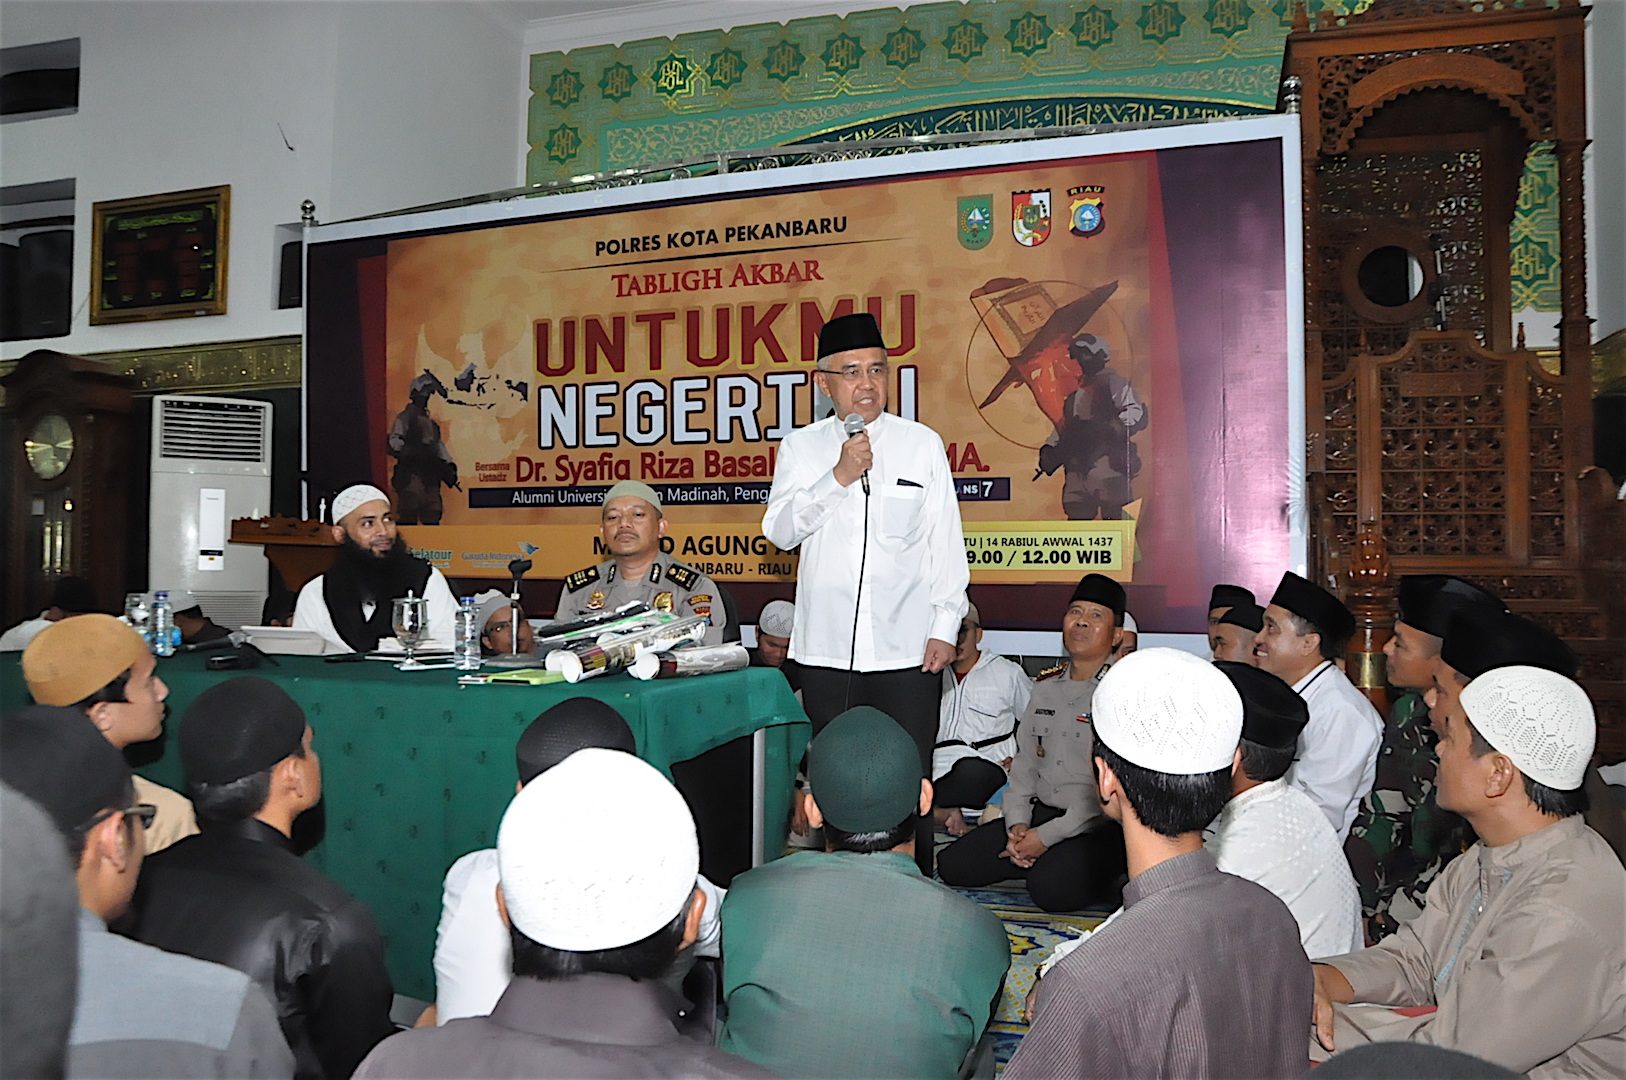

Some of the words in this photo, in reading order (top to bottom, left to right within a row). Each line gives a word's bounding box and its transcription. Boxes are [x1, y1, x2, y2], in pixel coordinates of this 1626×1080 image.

[1071, 186, 1101, 195] RIAU
[595, 234, 661, 256] POLRES
[667, 229, 719, 250] KOTA
[725, 216, 848, 243] PEKANBARU
[611, 268, 723, 298] TABLIGH
[731, 259, 825, 288] AKBAR
[475, 461, 510, 471] Bersama
[516, 456, 547, 482] Dr.
[641, 450, 694, 480] Riza
[704, 446, 776, 478] Basal
[512, 490, 554, 504] Alumni
[558, 488, 607, 503] Universi
[667, 486, 730, 503] Madinah,
[735, 486, 771, 503] Peng
[682, 535, 767, 556] AGUNG
[986, 537, 998, 547] 14
[1001, 537, 1039, 547] RABIUL
[1042, 537, 1084, 547] AWWAL
[1088, 537, 1113, 547] 1437
[966, 550, 1003, 565] 9.00
[1022, 550, 1071, 565] 12.00
[1076, 550, 1112, 565] WIB
[758, 562, 792, 575] RIAU
